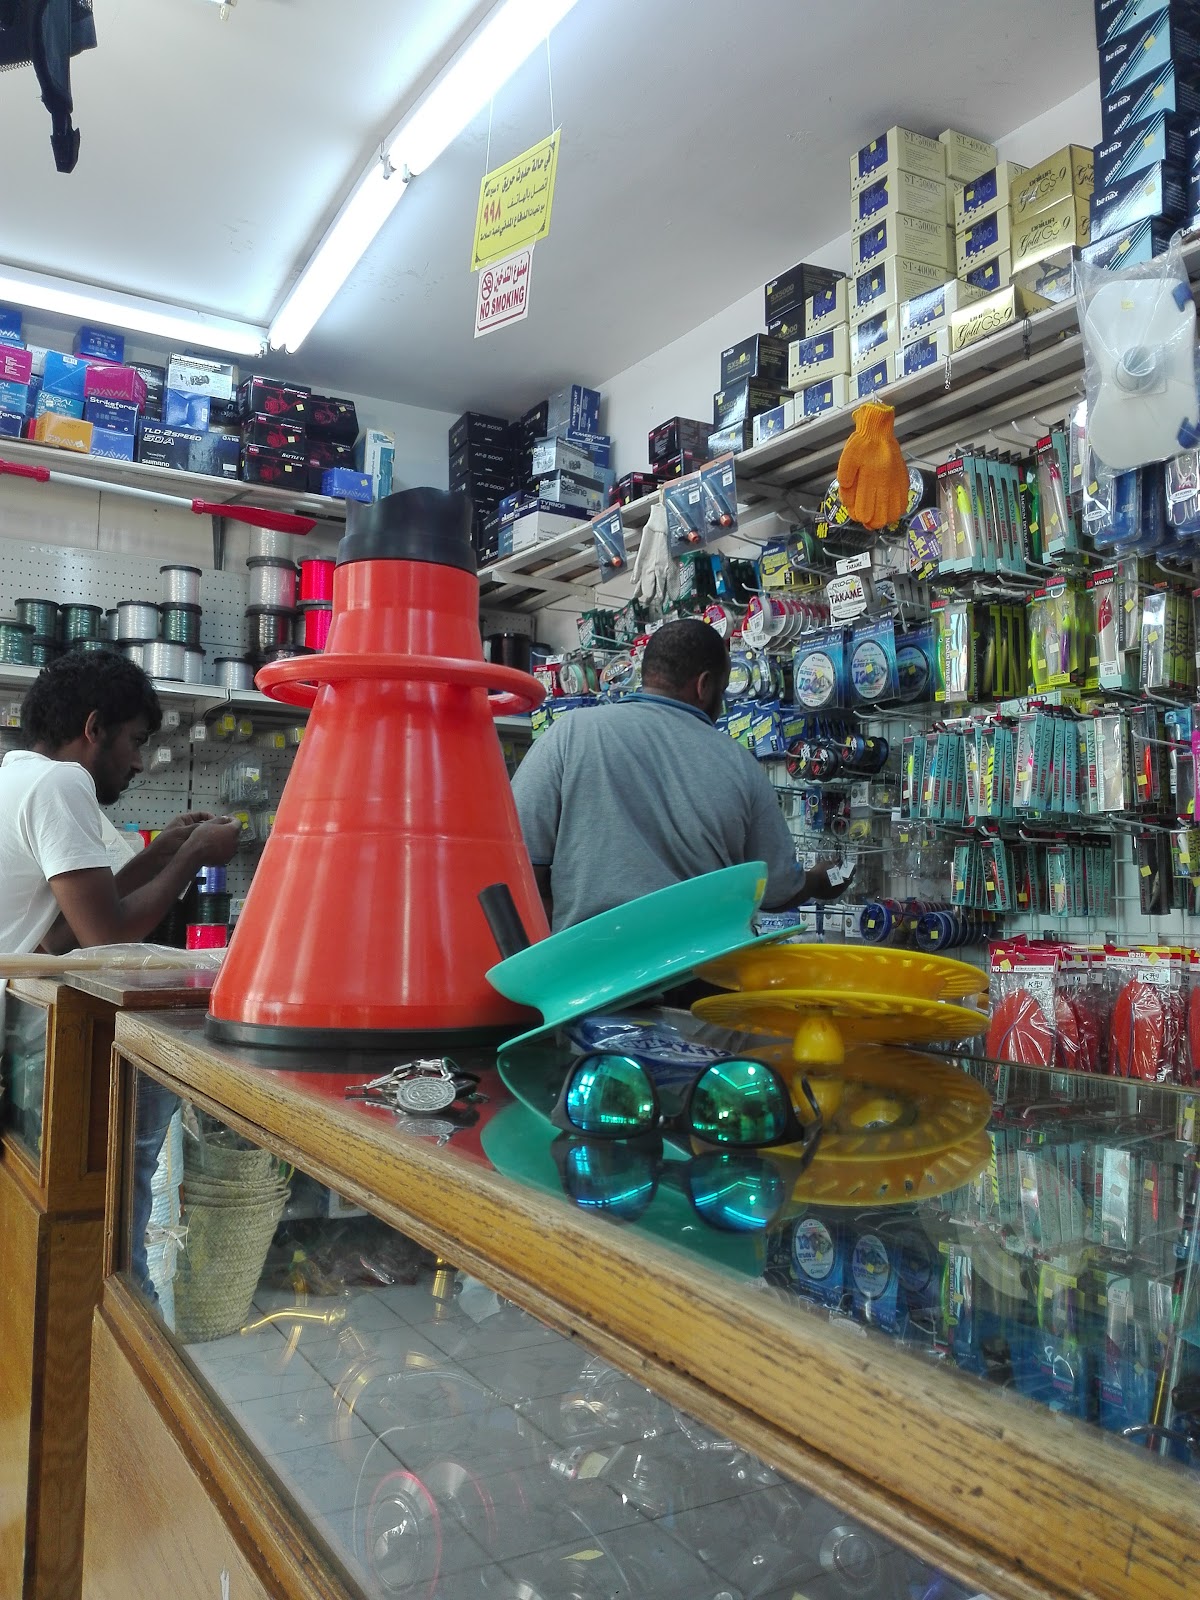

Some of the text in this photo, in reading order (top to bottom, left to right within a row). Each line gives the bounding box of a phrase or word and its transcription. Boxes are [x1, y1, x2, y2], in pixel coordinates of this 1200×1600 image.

[1105, 43, 1128, 62] benax
[1108, 95, 1131, 112] benax
[1100, 141, 1123, 158] benax
[1096, 190, 1119, 206] benax
[493, 260, 528, 293] ممنوع التدخين
[480, 285, 525, 321] NO SMOKING
[955, 322, 982, 348] Gold
[981, 306, 1014, 331] GS-9
[89, 396, 137, 411] Strikeforce
[141, 458, 171, 468] SHIMANO
[560, 480, 588, 497] Sealine
[829, 587, 864, 605] TAKAME
